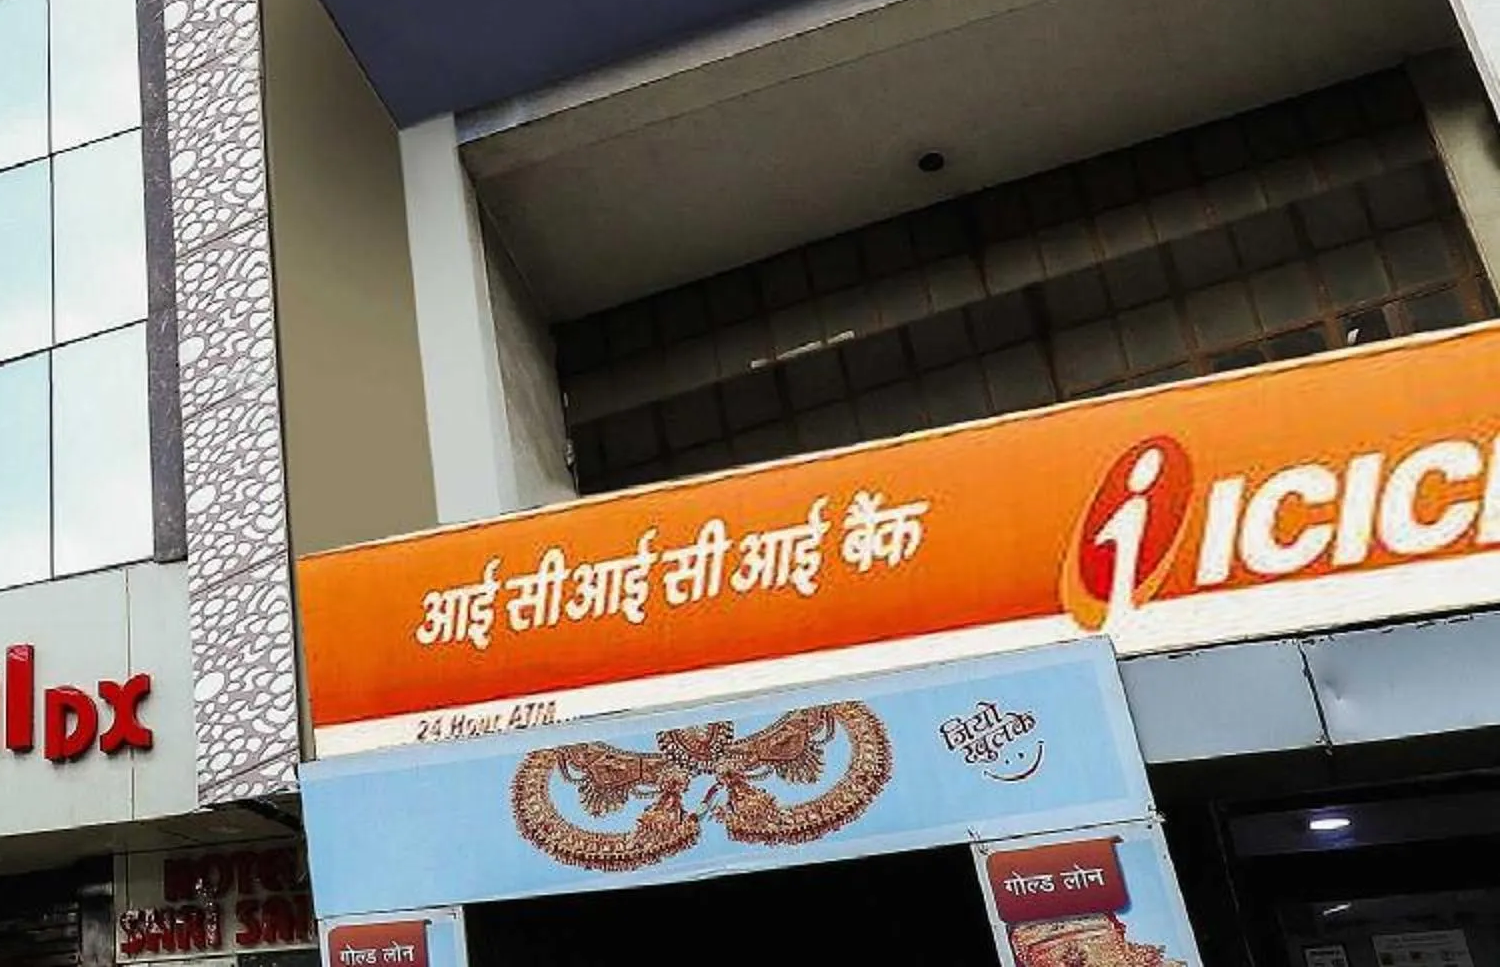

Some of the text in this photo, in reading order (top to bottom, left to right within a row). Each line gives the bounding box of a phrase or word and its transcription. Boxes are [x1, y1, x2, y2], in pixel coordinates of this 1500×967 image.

[415, 490, 932, 650] आई सी आई सी आई बैंक
[43, 672, 154, 763] DX
[417, 715, 442, 742] 24
[1003, 863, 1104, 895] गोल्ड लोन
[339, 941, 414, 965] गोल्ड लोन
